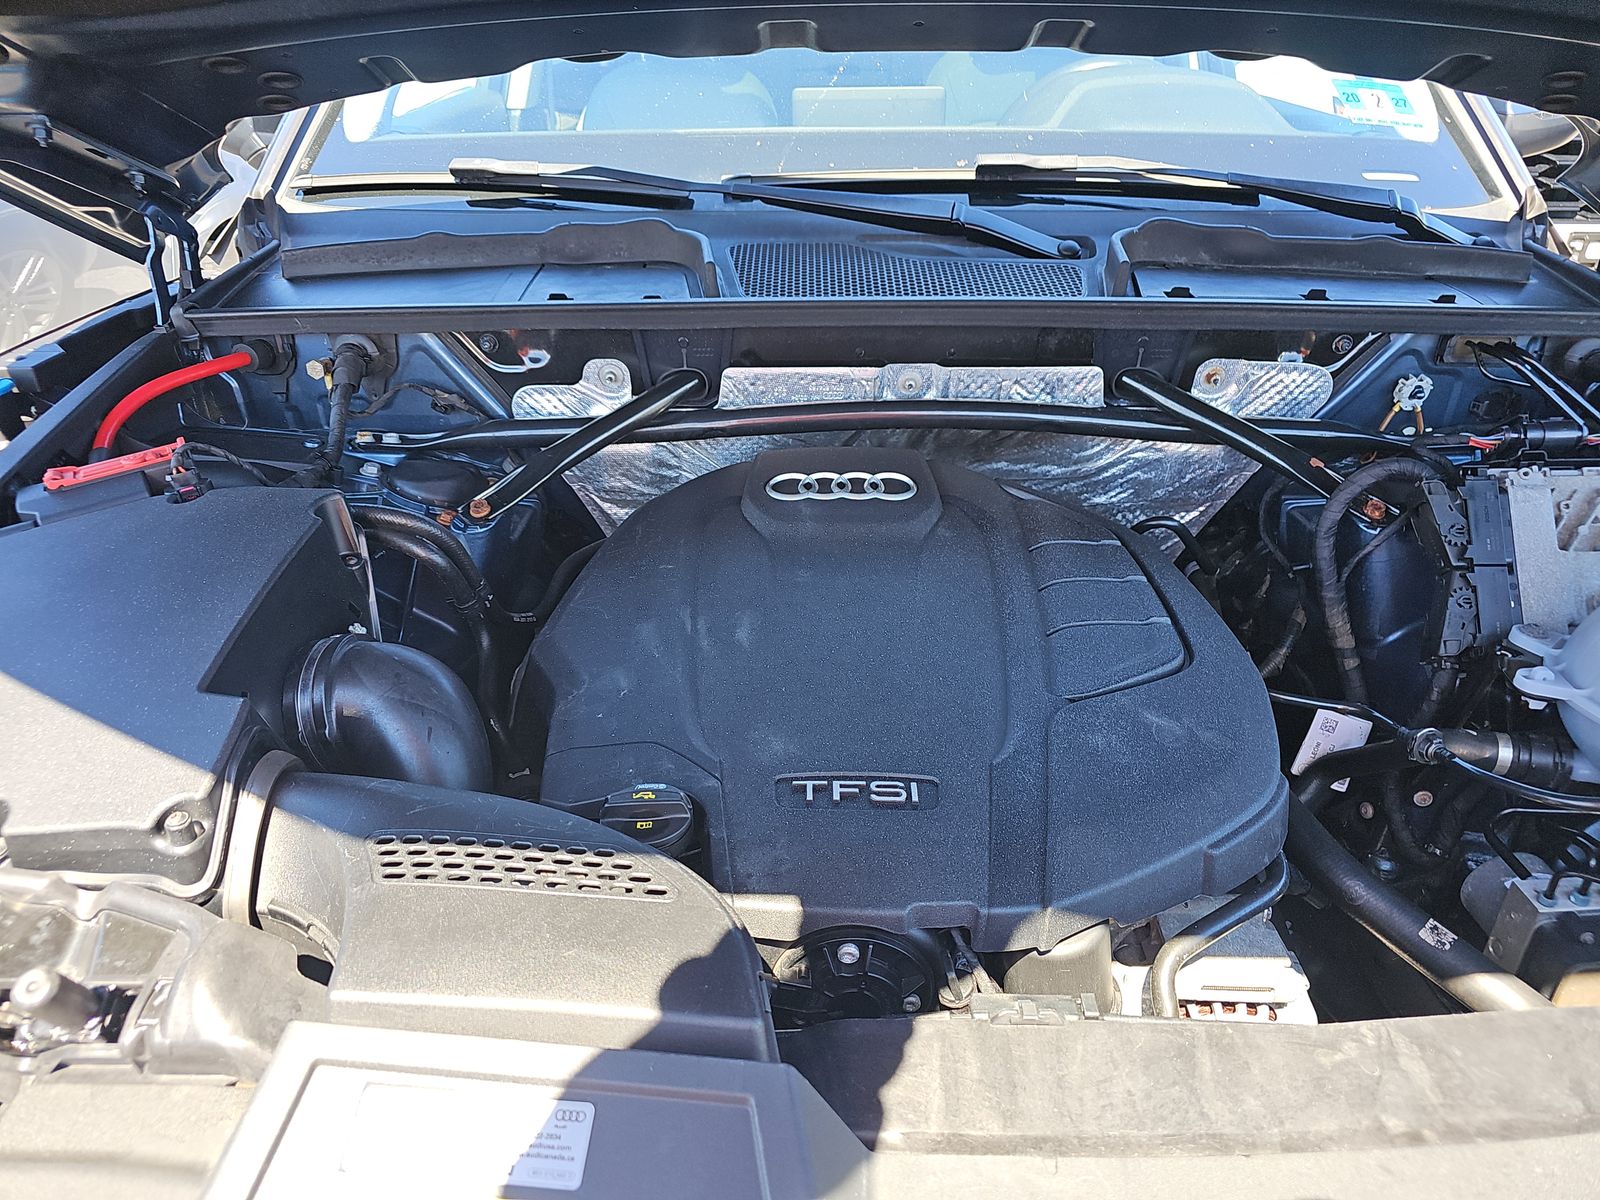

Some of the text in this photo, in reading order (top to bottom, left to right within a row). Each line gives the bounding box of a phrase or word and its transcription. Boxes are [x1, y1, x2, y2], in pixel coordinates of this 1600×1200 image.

[1342, 92, 1360, 103] 20
[1391, 97, 1407, 109] 27
[792, 780, 919, 804] TFSI
